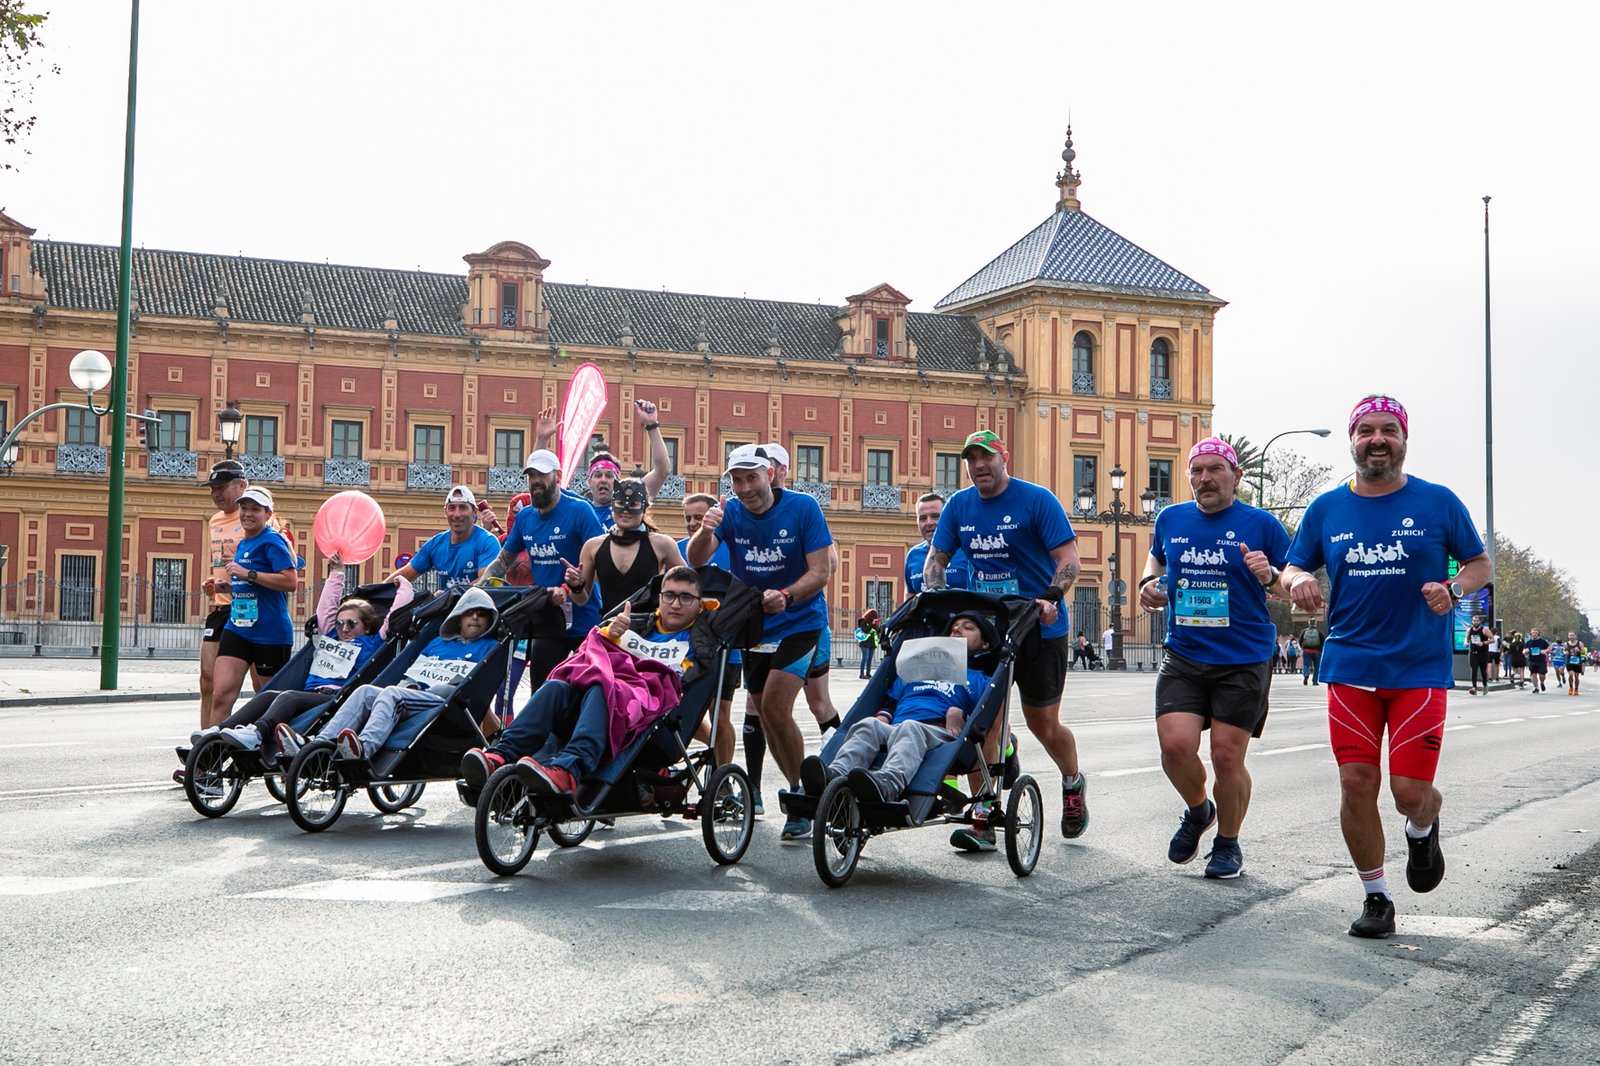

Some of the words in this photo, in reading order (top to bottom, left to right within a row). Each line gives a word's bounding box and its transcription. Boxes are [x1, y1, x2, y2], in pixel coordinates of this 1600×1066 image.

[985, 572, 1010, 580] ZURICH
[1189, 596, 1211, 604] 11503
[319, 640, 354, 661] aefat
[627, 638, 680, 659] aefat
[319, 660, 335, 671] SARA
[423, 662, 468, 675] aefat
